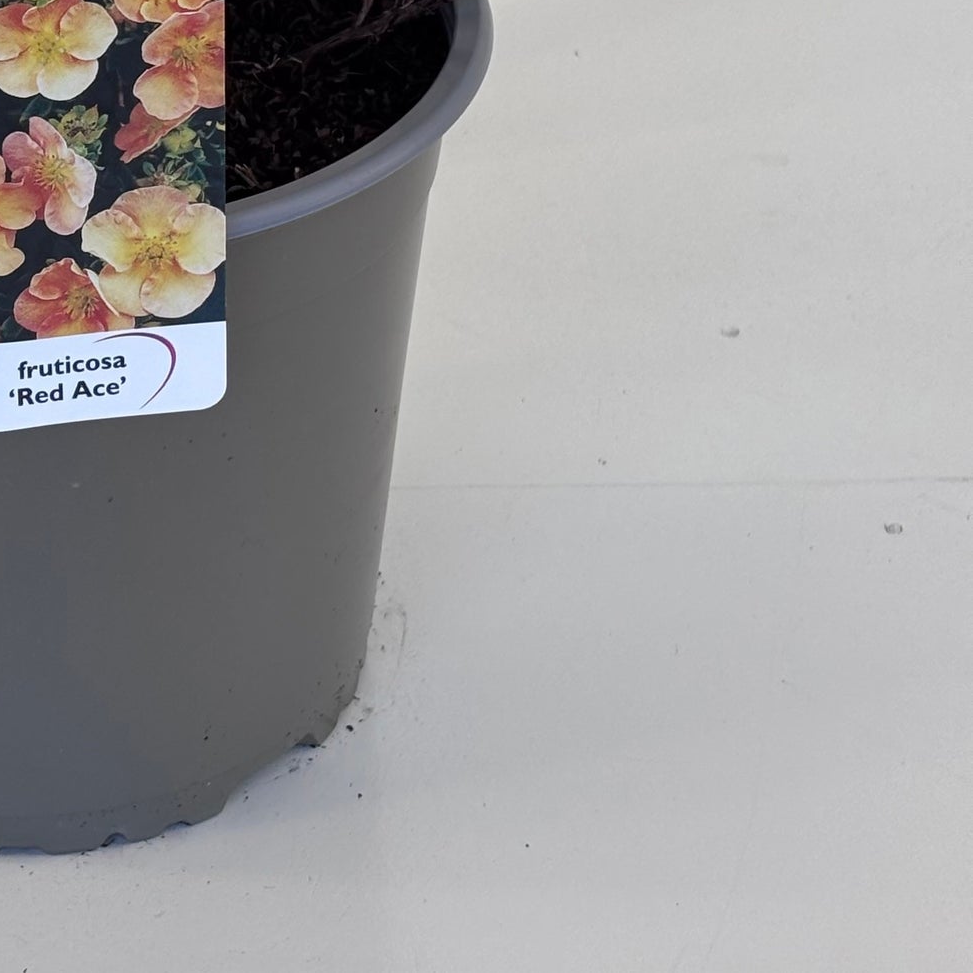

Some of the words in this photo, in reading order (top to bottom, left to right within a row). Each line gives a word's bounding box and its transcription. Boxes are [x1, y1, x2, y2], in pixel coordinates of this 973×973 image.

[18, 355, 127, 380] fruticosa
[9, 383, 64, 407] ‘Red
[72, 376, 127, 400] Ace’
